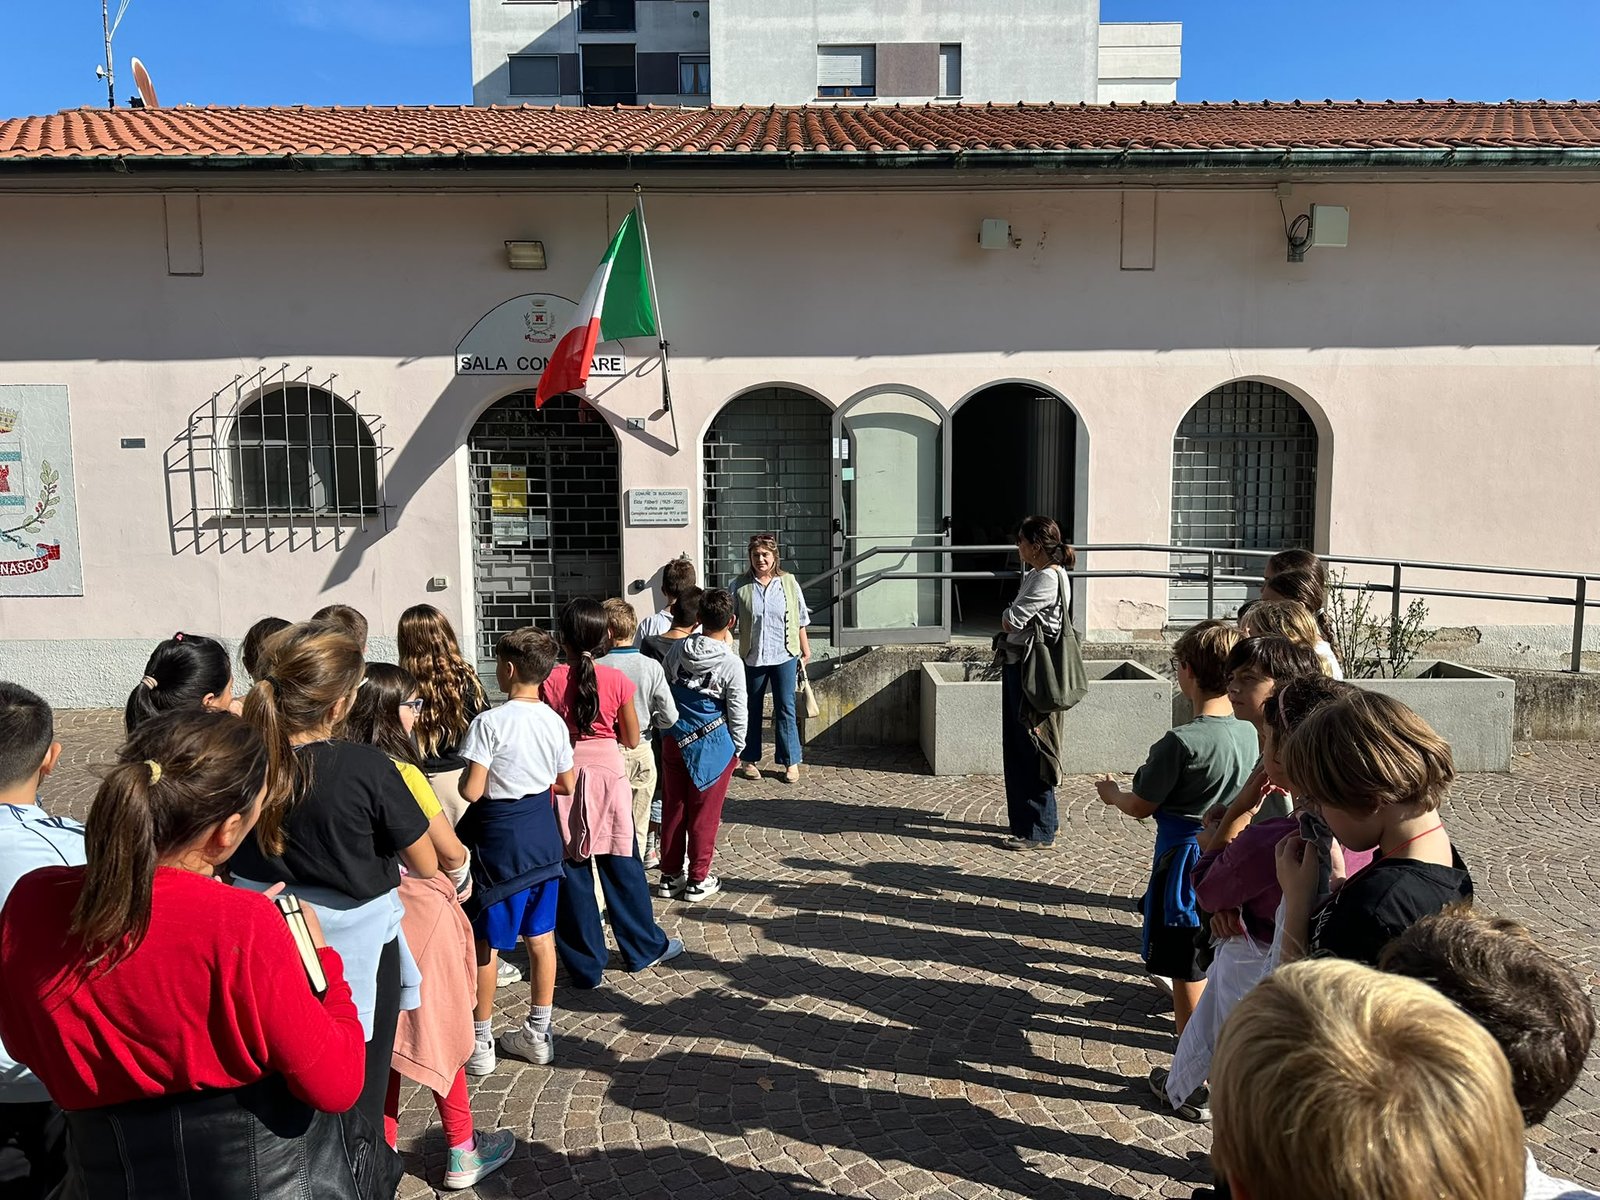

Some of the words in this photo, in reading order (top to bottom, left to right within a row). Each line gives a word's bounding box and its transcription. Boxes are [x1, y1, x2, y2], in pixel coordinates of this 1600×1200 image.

[461, 356, 508, 371] SALA
[516, 356, 621, 371] CONARE
[0, 559, 43, 574] NASCO
